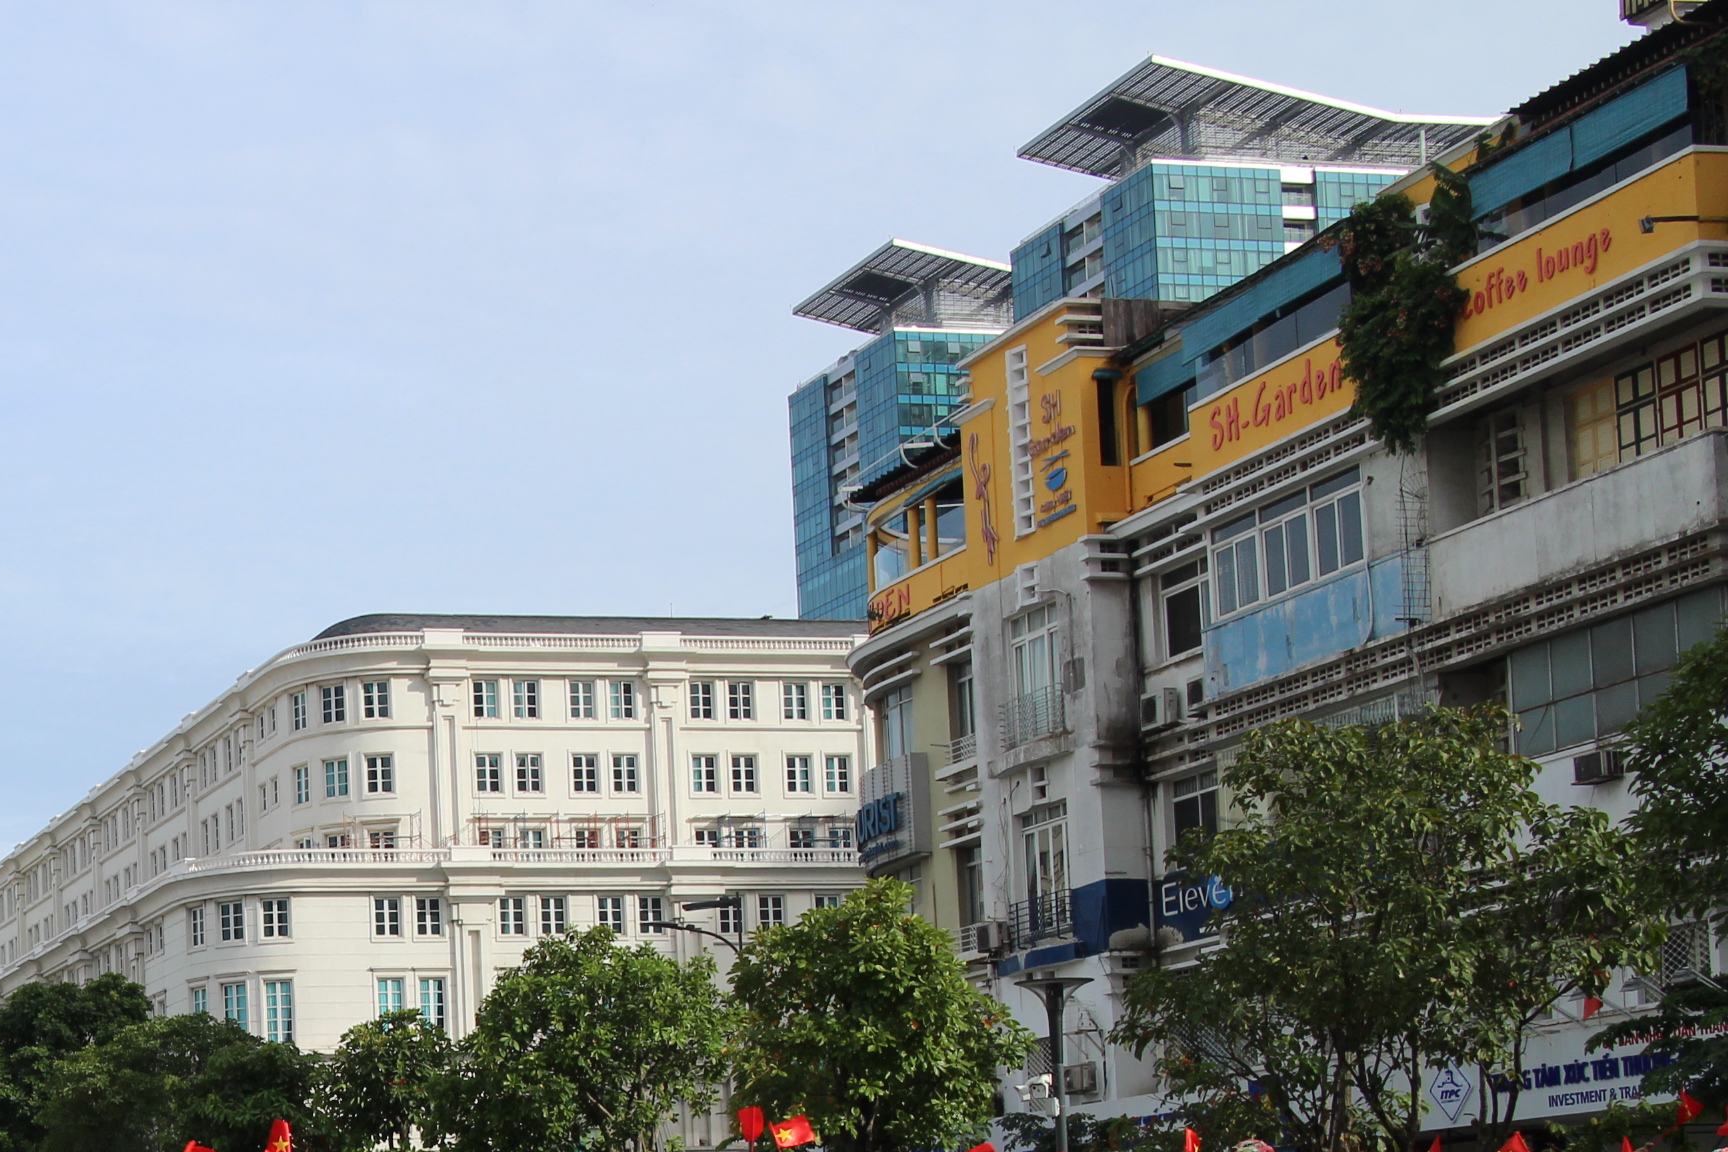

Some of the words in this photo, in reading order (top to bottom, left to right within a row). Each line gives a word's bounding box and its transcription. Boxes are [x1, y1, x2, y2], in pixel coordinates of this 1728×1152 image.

[1460, 266, 1528, 320] coffee
[1535, 227, 1612, 283] lounge
[1208, 358, 1342, 452] SH-Garden
[856, 792, 900, 844] URIST
[1440, 1088, 1461, 1100] ITPC
[1548, 1088, 1608, 1108] INVESTMENT
